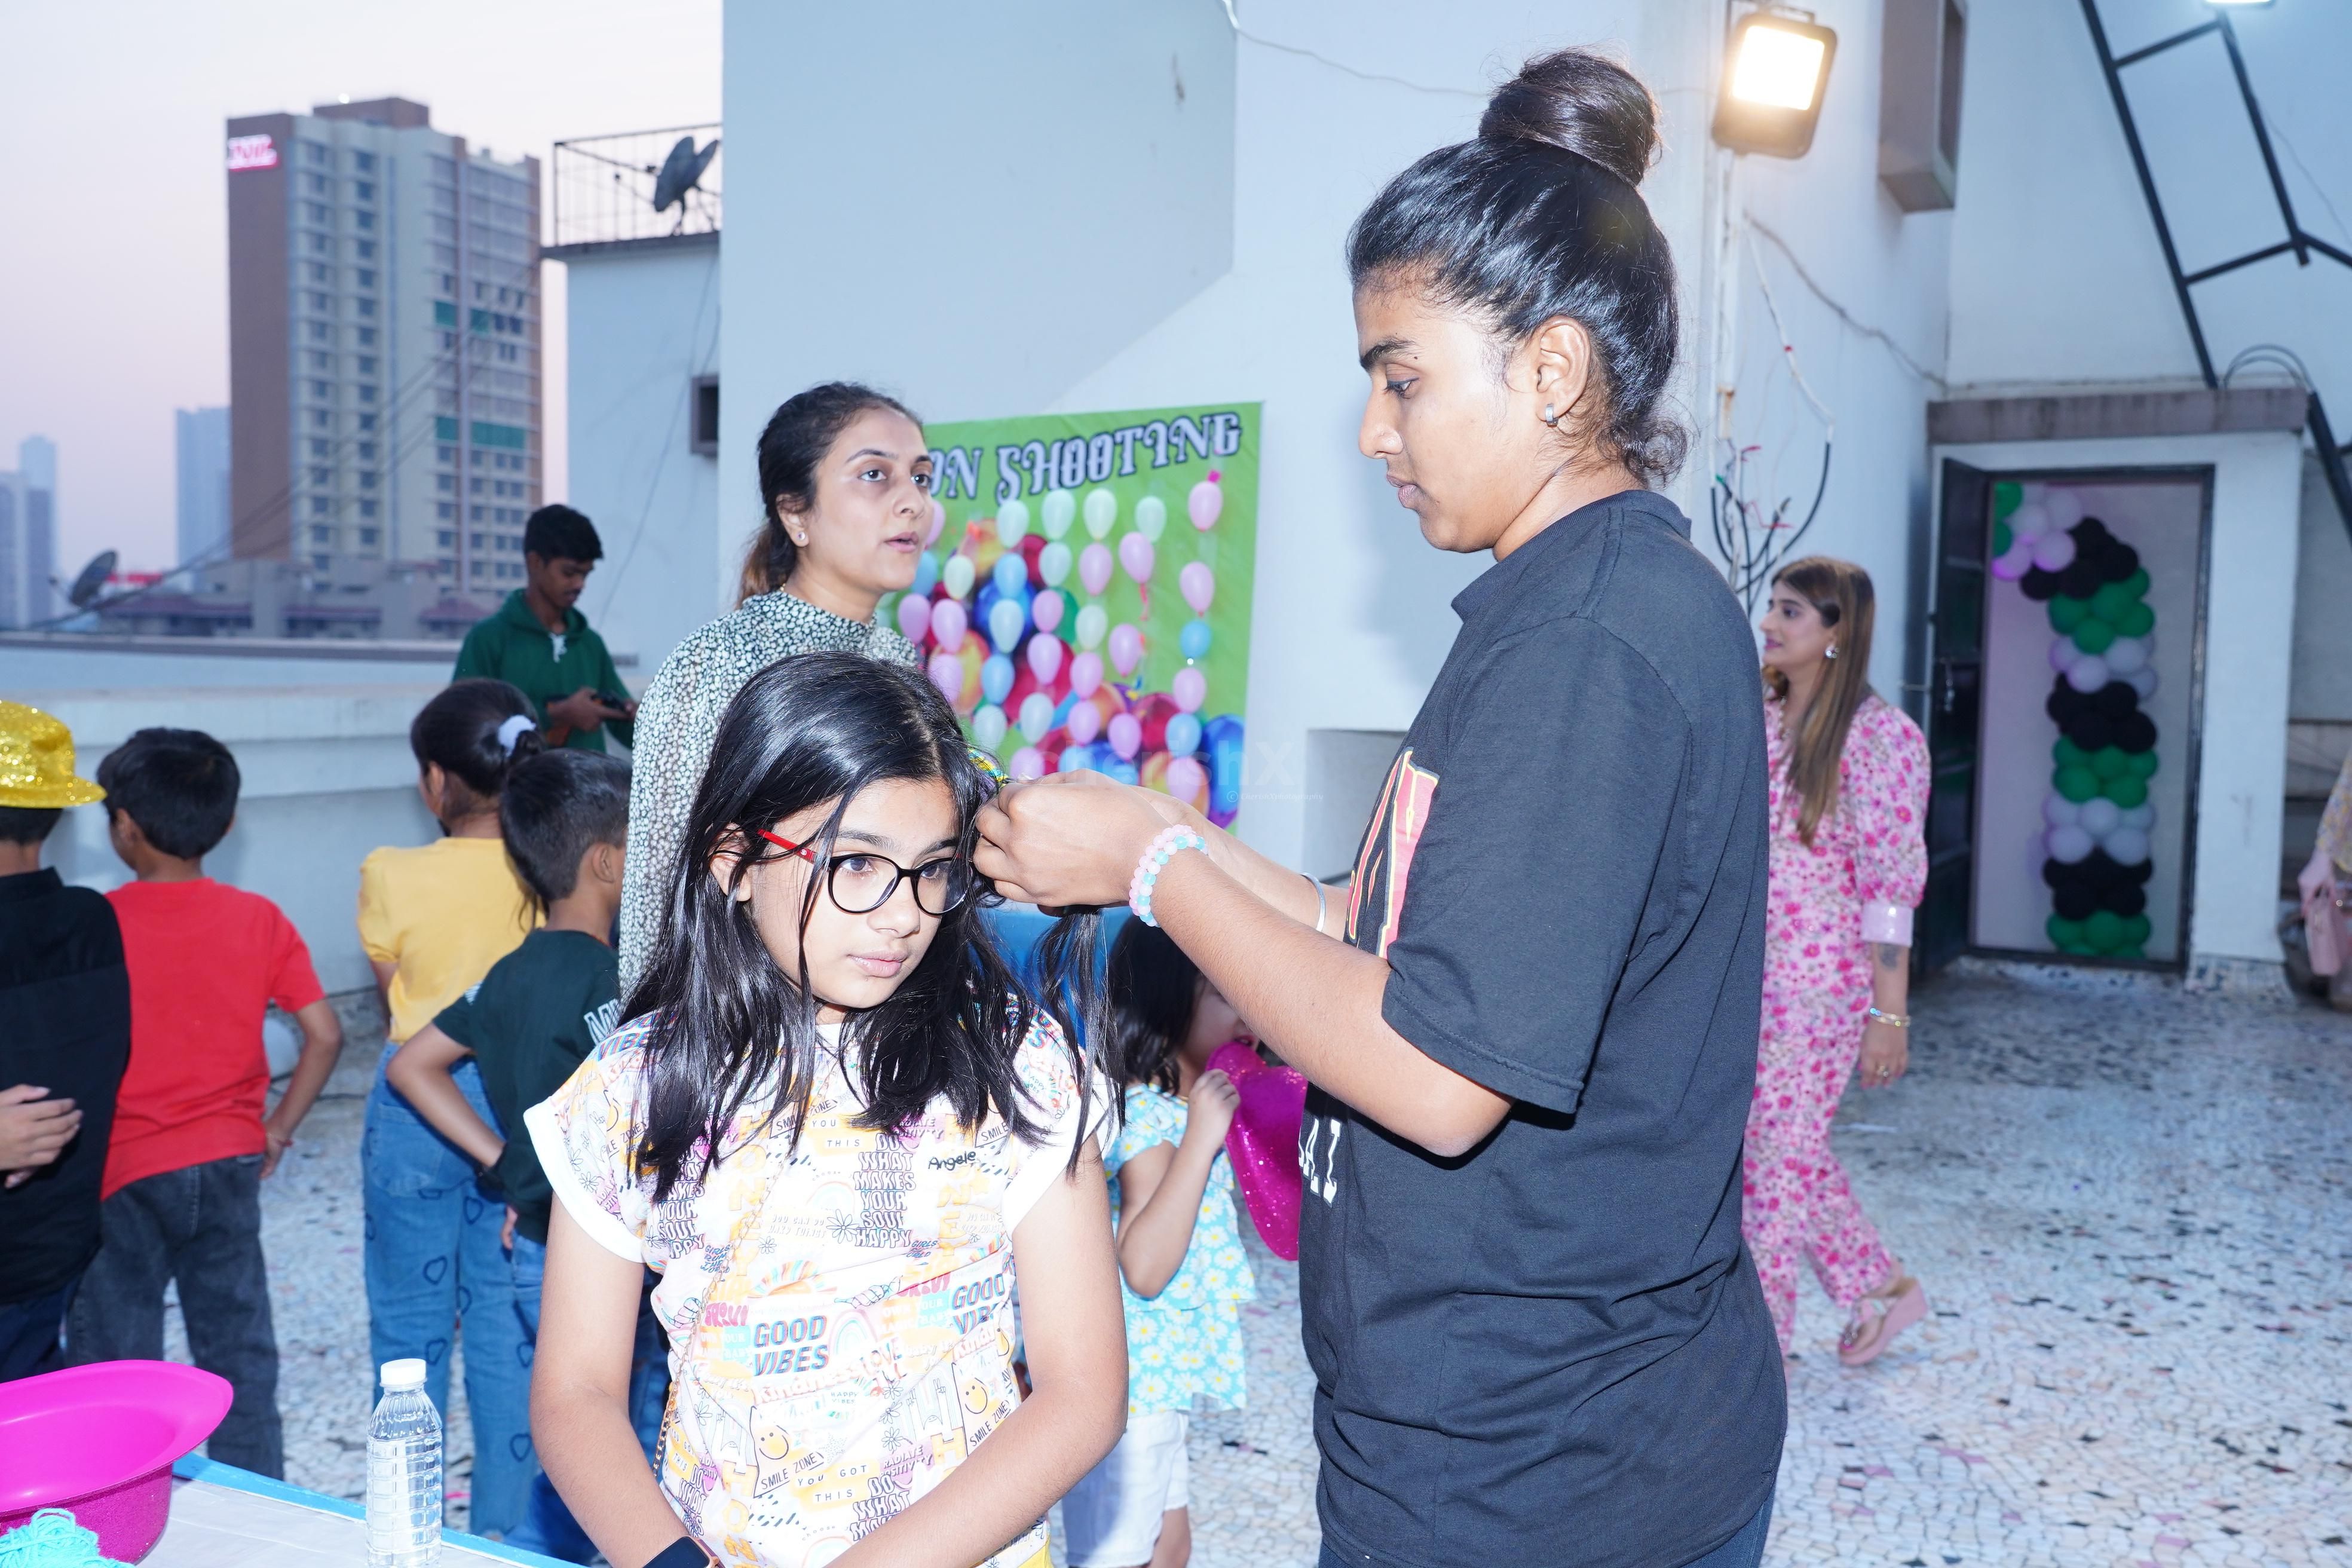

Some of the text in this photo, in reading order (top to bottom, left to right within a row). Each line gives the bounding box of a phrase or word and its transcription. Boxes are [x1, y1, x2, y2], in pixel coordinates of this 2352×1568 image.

[994, 411, 1244, 508] SHOOTING
[597, 1029, 651, 1062] VIBE
[1029, 1075, 1047, 1091] APPY
[812, 1120, 836, 1128] YOU
[981, 1122, 1010, 1142] SMILE
[826, 1139, 860, 1147] THIS
[858, 1152, 914, 1171] WHAT
[927, 1151, 976, 1172] Angele
[668, 1181, 706, 1202] AKES
[853, 1171, 917, 1191] MAKES
[657, 1199, 698, 1221] YOUR
[861, 1190, 908, 1211] YOUR
[658, 1220, 697, 1241] SOUL
[860, 1210, 904, 1230] SOUL
[669, 1234, 705, 1259] PPY
[855, 1228, 912, 1249] HAPPY
[911, 1240, 938, 1248] GIRLS
[705, 1244, 730, 1256] GIRLS
[754, 1315, 828, 1348] GOOD
[753, 1344, 829, 1377] VIBES
[970, 1420, 993, 1447] SMILE
[992, 1401, 1008, 1424] ZONE
[673, 1452, 688, 1471] THIS
[761, 1452, 817, 1490] SMILE ZONE
[690, 1463, 705, 1489] DO
[798, 1465, 867, 1487] YOU GOT
[868, 1474, 895, 1498] DO
[678, 1478, 708, 1515] WHAT
[815, 1489, 853, 1502] THIS
[852, 1490, 910, 1521] WHAT
